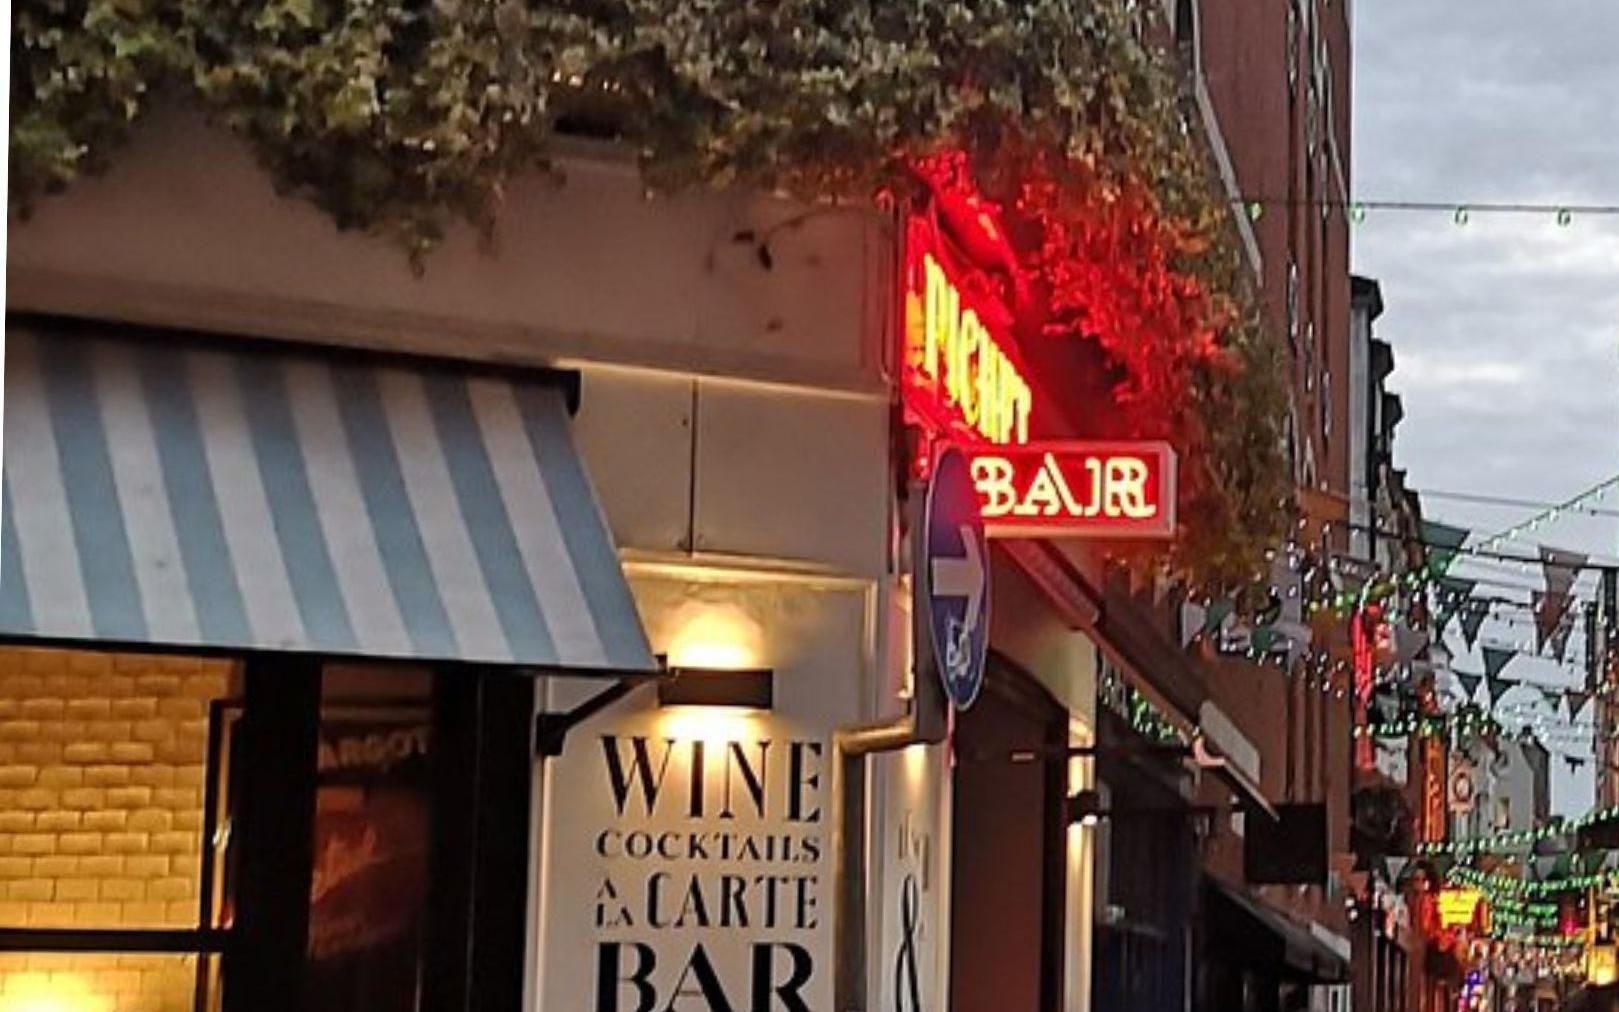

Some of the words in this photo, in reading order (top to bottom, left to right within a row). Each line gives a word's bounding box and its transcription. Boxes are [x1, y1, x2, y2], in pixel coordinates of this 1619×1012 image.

[970, 452, 1156, 517] BAR
[598, 735, 822, 822] WINE
[596, 829, 820, 863] COCKTAILS
[596, 904, 633, 927] LA
[647, 872, 818, 928] CARTE
[595, 941, 814, 1012] BAR
